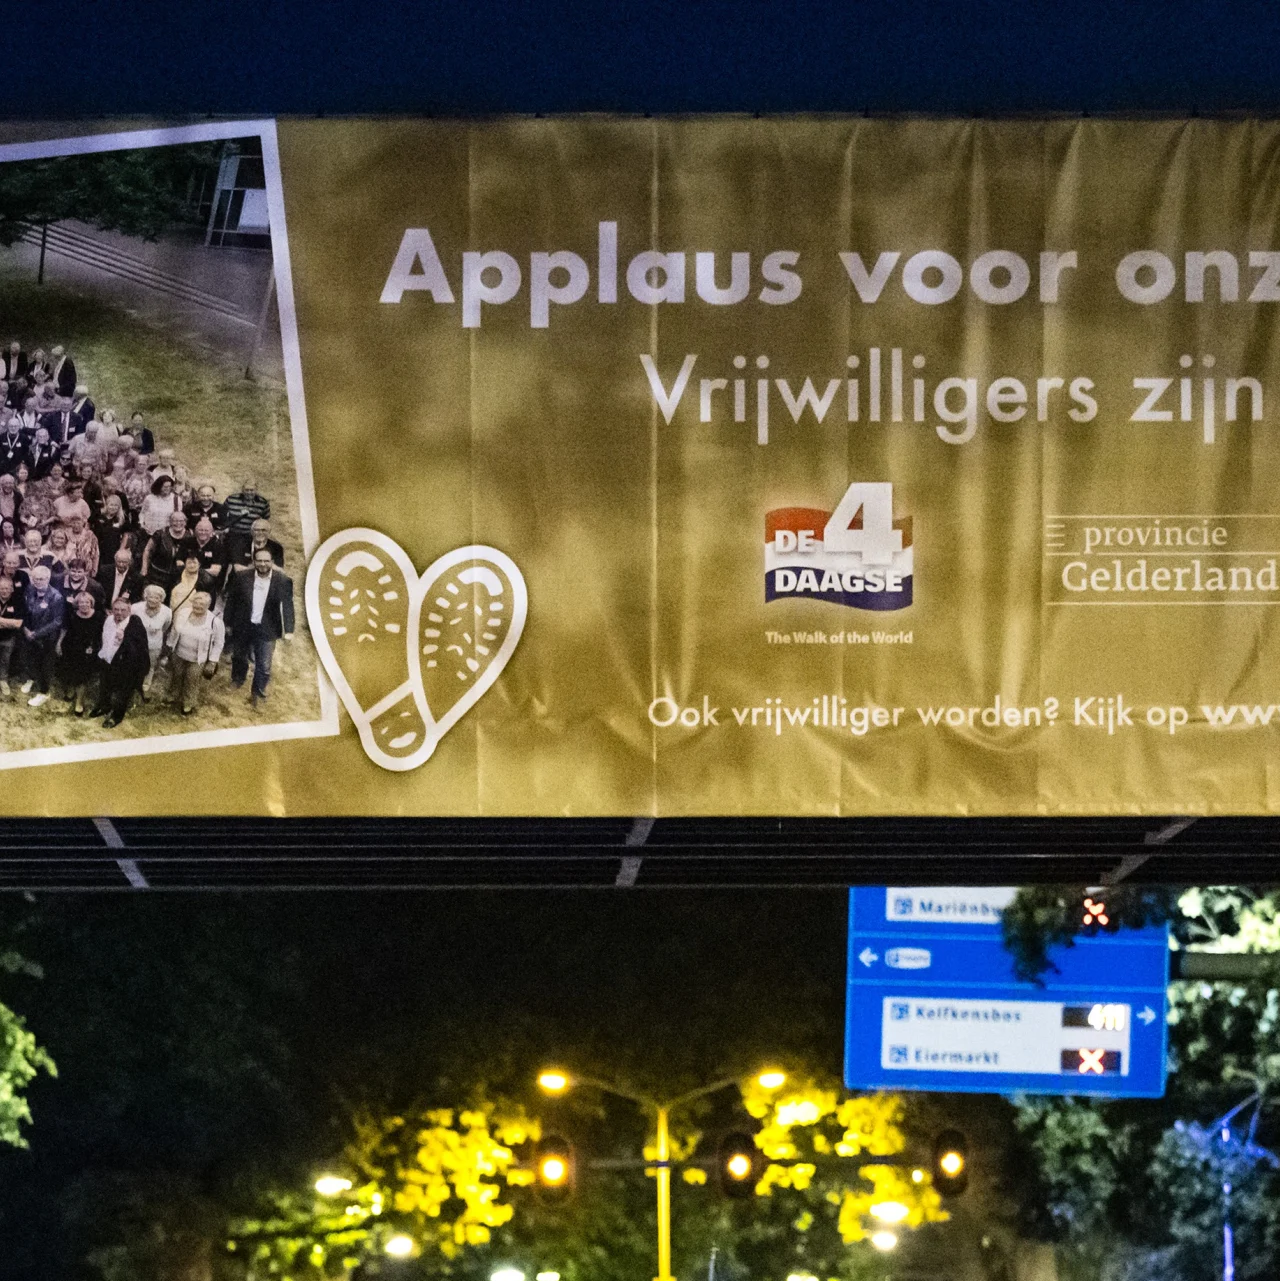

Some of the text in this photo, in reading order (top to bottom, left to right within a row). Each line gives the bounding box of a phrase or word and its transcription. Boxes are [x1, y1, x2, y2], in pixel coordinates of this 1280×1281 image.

[379, 221, 803, 328] Applaus
[839, 249, 1078, 306] voor
[640, 347, 1099, 445] Vrijwilligers
[1130, 355, 1264, 444] zijn
[775, 482, 902, 565] DE 4
[1083, 519, 1228, 554] provincie
[775, 569, 903, 592] DAAGSE
[1061, 559, 1279, 591] Gelderland
[765, 632, 913, 644] The Walk of the World
[648, 696, 719, 727] Ook
[732, 696, 904, 736] vrijwilliger
[917, 697, 1059, 728] worden?
[1074, 696, 1132, 736] Kijk
[1146, 705, 1188, 734] op
